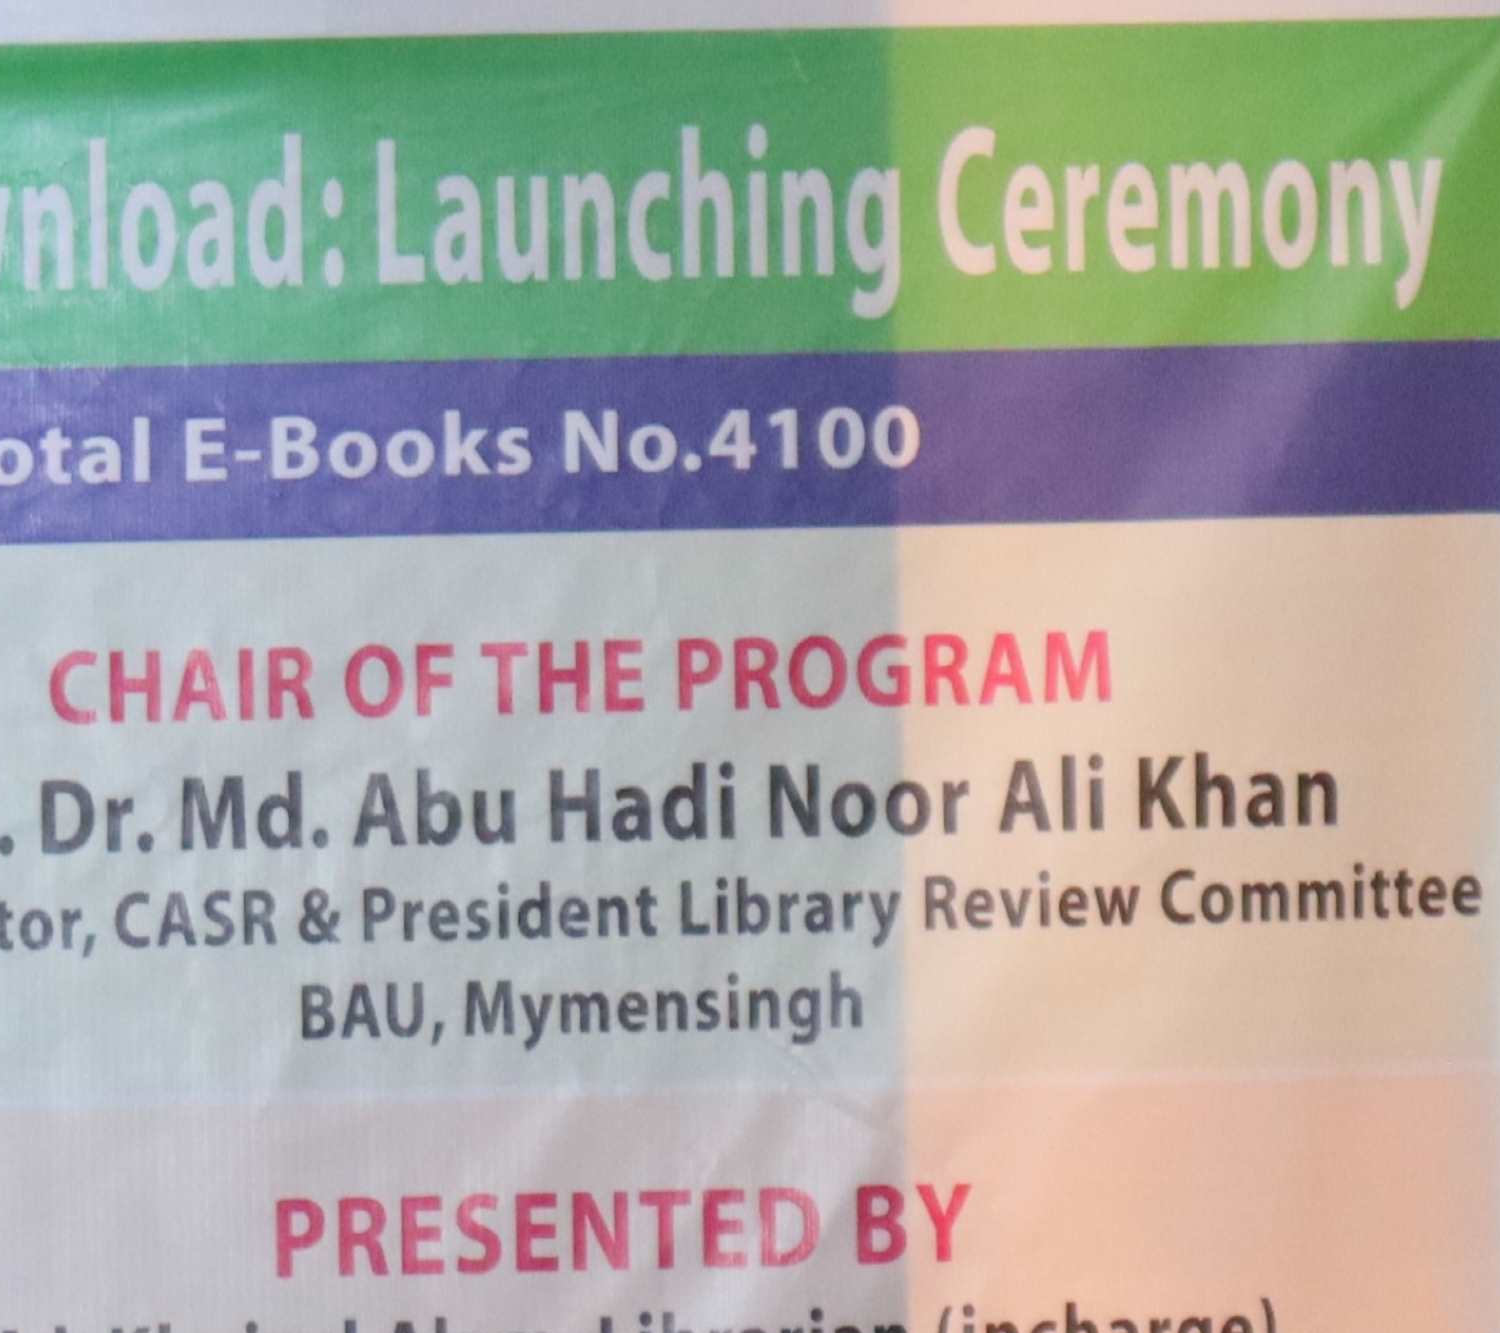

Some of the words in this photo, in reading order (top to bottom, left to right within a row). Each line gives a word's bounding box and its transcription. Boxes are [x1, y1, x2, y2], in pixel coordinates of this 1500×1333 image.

[376, 122, 901, 320] Launching
[937, 126, 1444, 309] Ceremony
[186, 410, 532, 481] E-Books
[564, 405, 920, 473] No.4100
[49, 647, 314, 724] CHAIR
[344, 643, 453, 718] OF
[481, 640, 644, 715] THE
[678, 630, 1111, 710] PROGRAM
[41, 780, 154, 854] Dr.
[181, 771, 328, 851] Md.
[353, 768, 515, 846] Abu
[550, 762, 734, 842] Hadi
[769, 764, 968, 838] Noor
[999, 754, 1104, 833] Ali
[1139, 752, 1337, 829] Khan
[115, 890, 276, 948] CASR
[298, 888, 340, 944] &
[363, 881, 657, 942] President
[680, 876, 900, 948] Library
[925, 871, 1140, 930] Review
[1161, 863, 1481, 924] Committee
[301, 982, 444, 1045] BAU,
[465, 971, 862, 1051] Mymensingh
[276, 1187, 818, 1278] PRESENTED
[856, 1184, 970, 1264] BY
